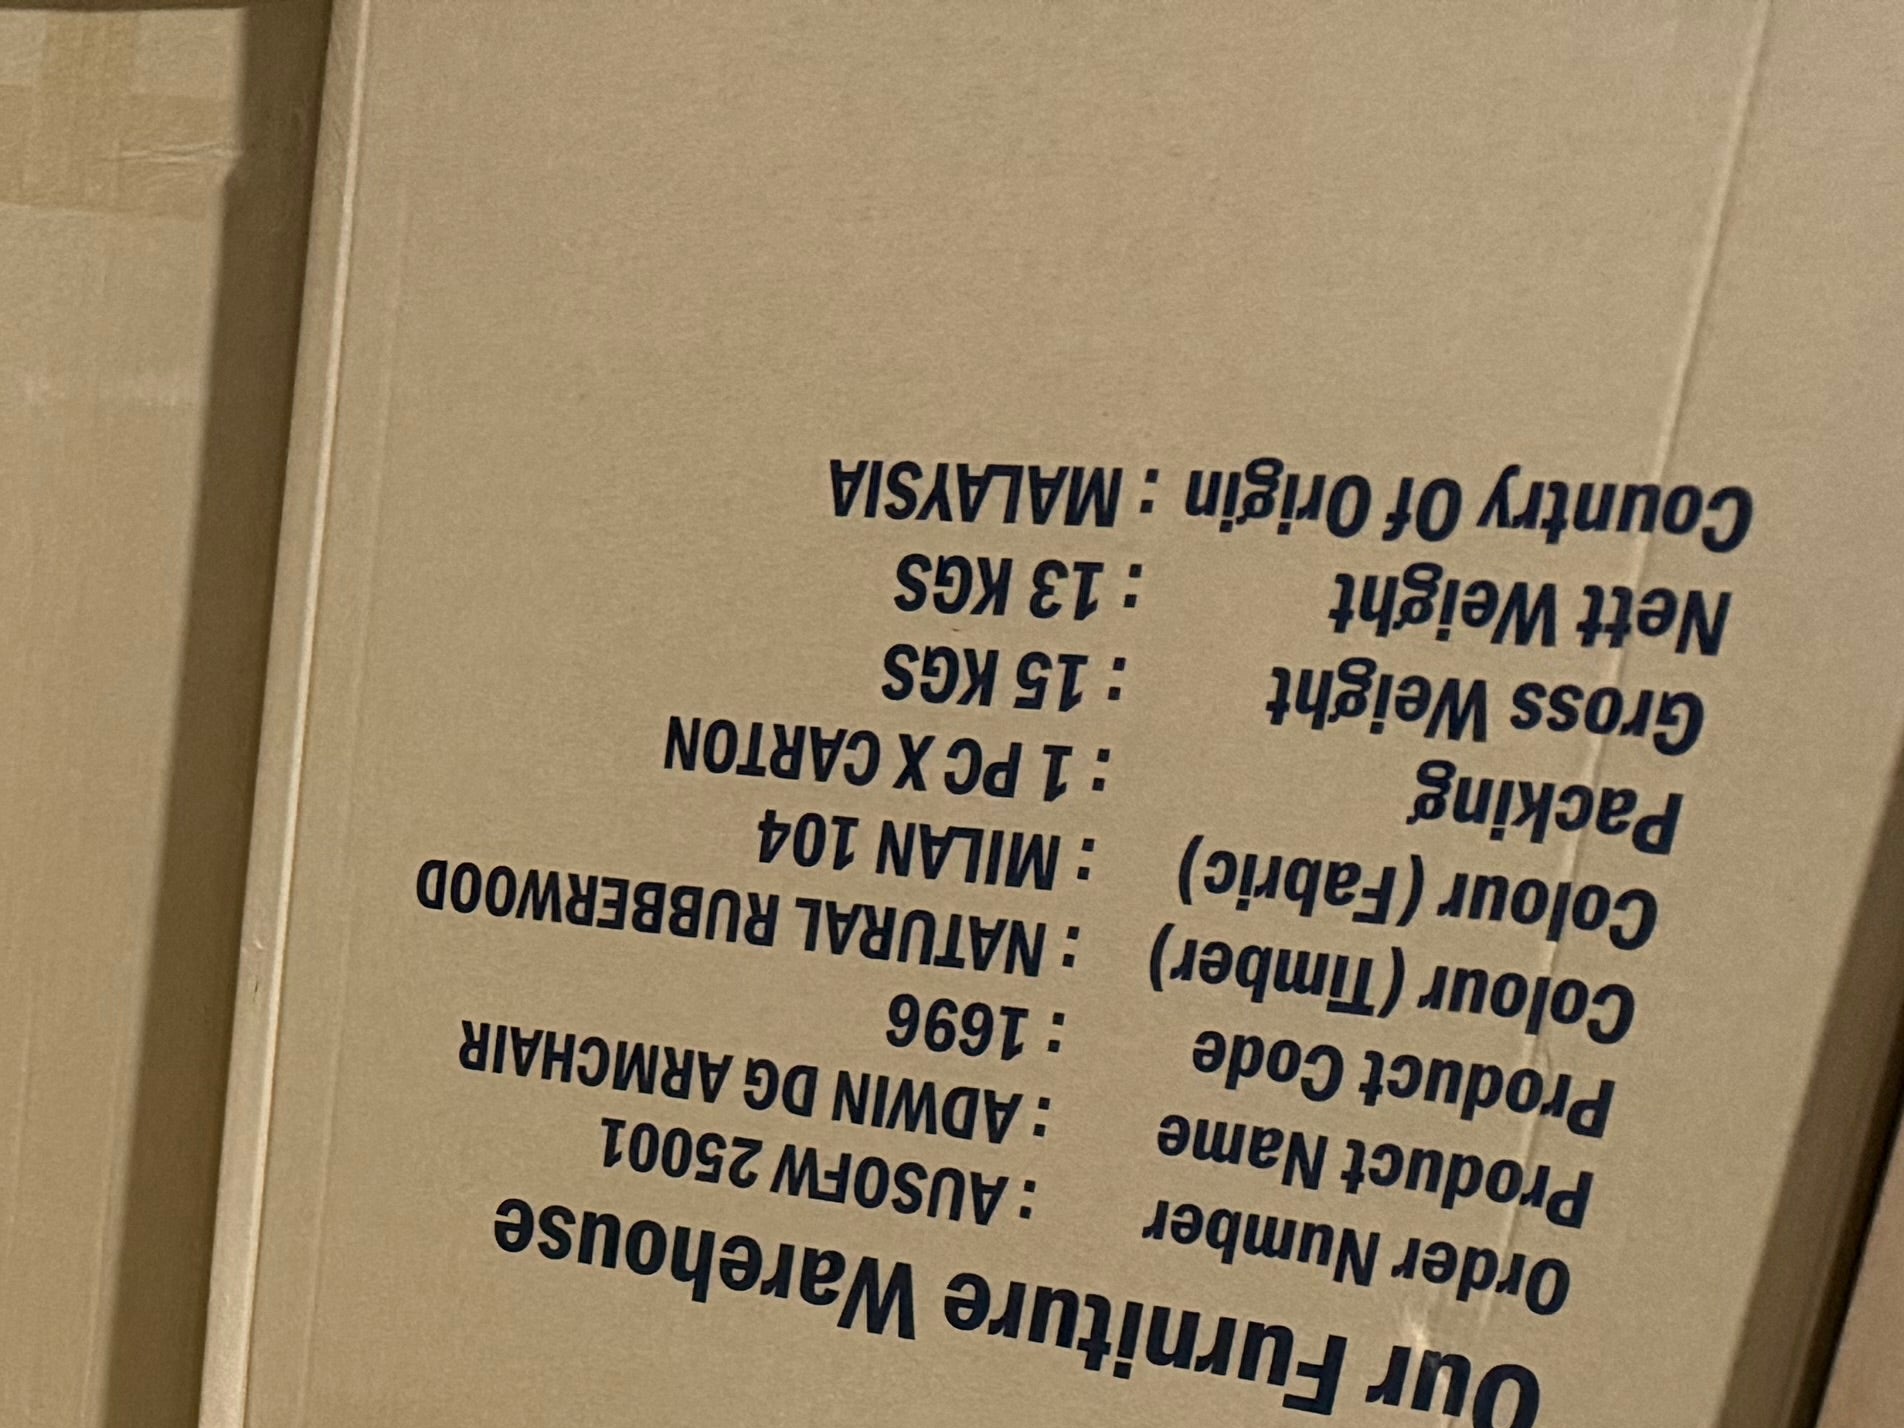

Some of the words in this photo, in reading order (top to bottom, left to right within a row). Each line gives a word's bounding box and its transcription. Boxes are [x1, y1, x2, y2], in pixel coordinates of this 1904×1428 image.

[893, 552, 1014, 617] KGS
[1028, 558, 1105, 622] 13
[1327, 561, 1557, 648] Weight
[1575, 584, 1732, 657] Nett
[757, 808, 860, 871] 104
[875, 819, 1061, 891] MILAN
[1178, 834, 1425, 928] (Fabric)
[1436, 872, 1658, 951] Colour
[458, 1019, 734, 1104] ARMCHAIR
[742, 1057, 819, 1118] DG
[831, 1069, 1024, 1145] ADWIN
[600, 1117, 764, 1189] 25001
[769, 1143, 1010, 1226] AUSOFW
[1157, 1114, 1329, 1191] Name
[1340, 1138, 1594, 1230] Product
[493, 1197, 916, 1341] Warehouse
[1141, 1199, 1381, 1287] Number
[1390, 1237, 1571, 1316] Order
[943, 1272, 1348, 1416] Furniture
